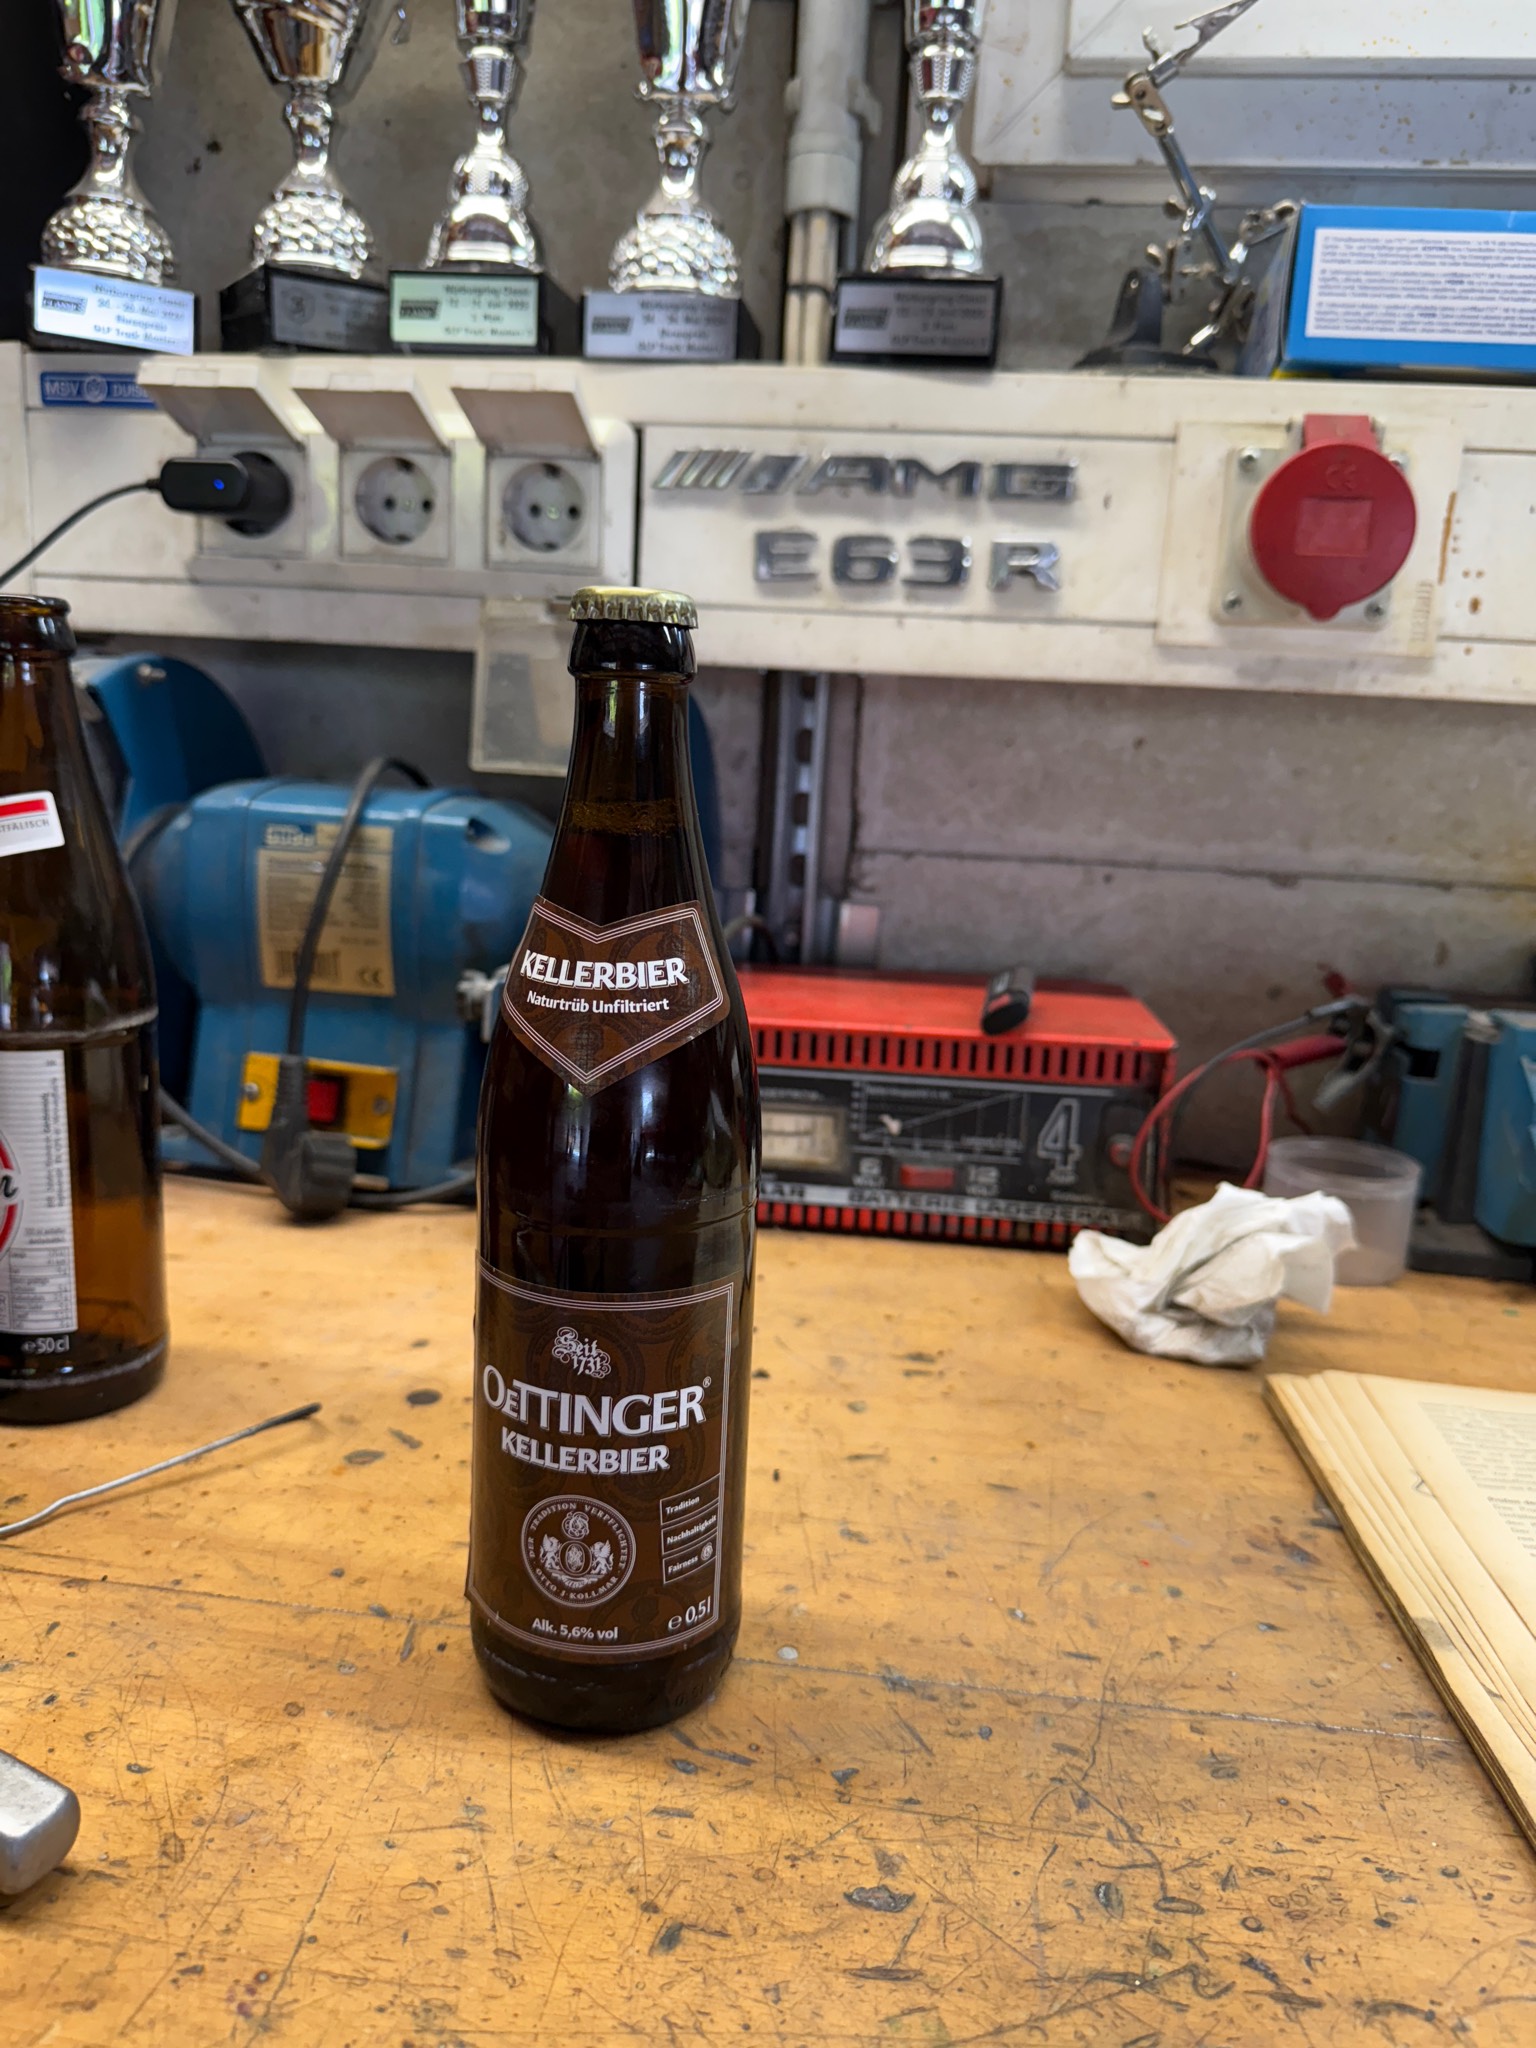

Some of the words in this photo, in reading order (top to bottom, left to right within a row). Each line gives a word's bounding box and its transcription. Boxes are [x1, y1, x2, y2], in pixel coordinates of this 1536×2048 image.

[797, 453, 1077, 501] AMG
[754, 531, 973, 588] E63
[988, 537, 1060, 590] R
[520, 949, 690, 991] KELLERBIER
[527, 990, 590, 1013] Naturtrüb
[592, 998, 670, 1014] Unfiltriert
[1037, 1098, 1083, 1169] 4
[552, 1326, 598, 1363] Seit
[502, 1425, 670, 1475] KELLERBIER
[529, 1502, 578, 1532] TRADITION
[665, 1496, 700, 1515] Tradition
[666, 1514, 717, 1545] Nachhaltigkeit
[667, 1555, 699, 1575] Fairness
[685, 1596, 711, 1624] 0,5l
[532, 1617, 557, 1635] Alk.
[560, 1624, 594, 1640] 5,6%
[596, 1626, 619, 1640] vol
